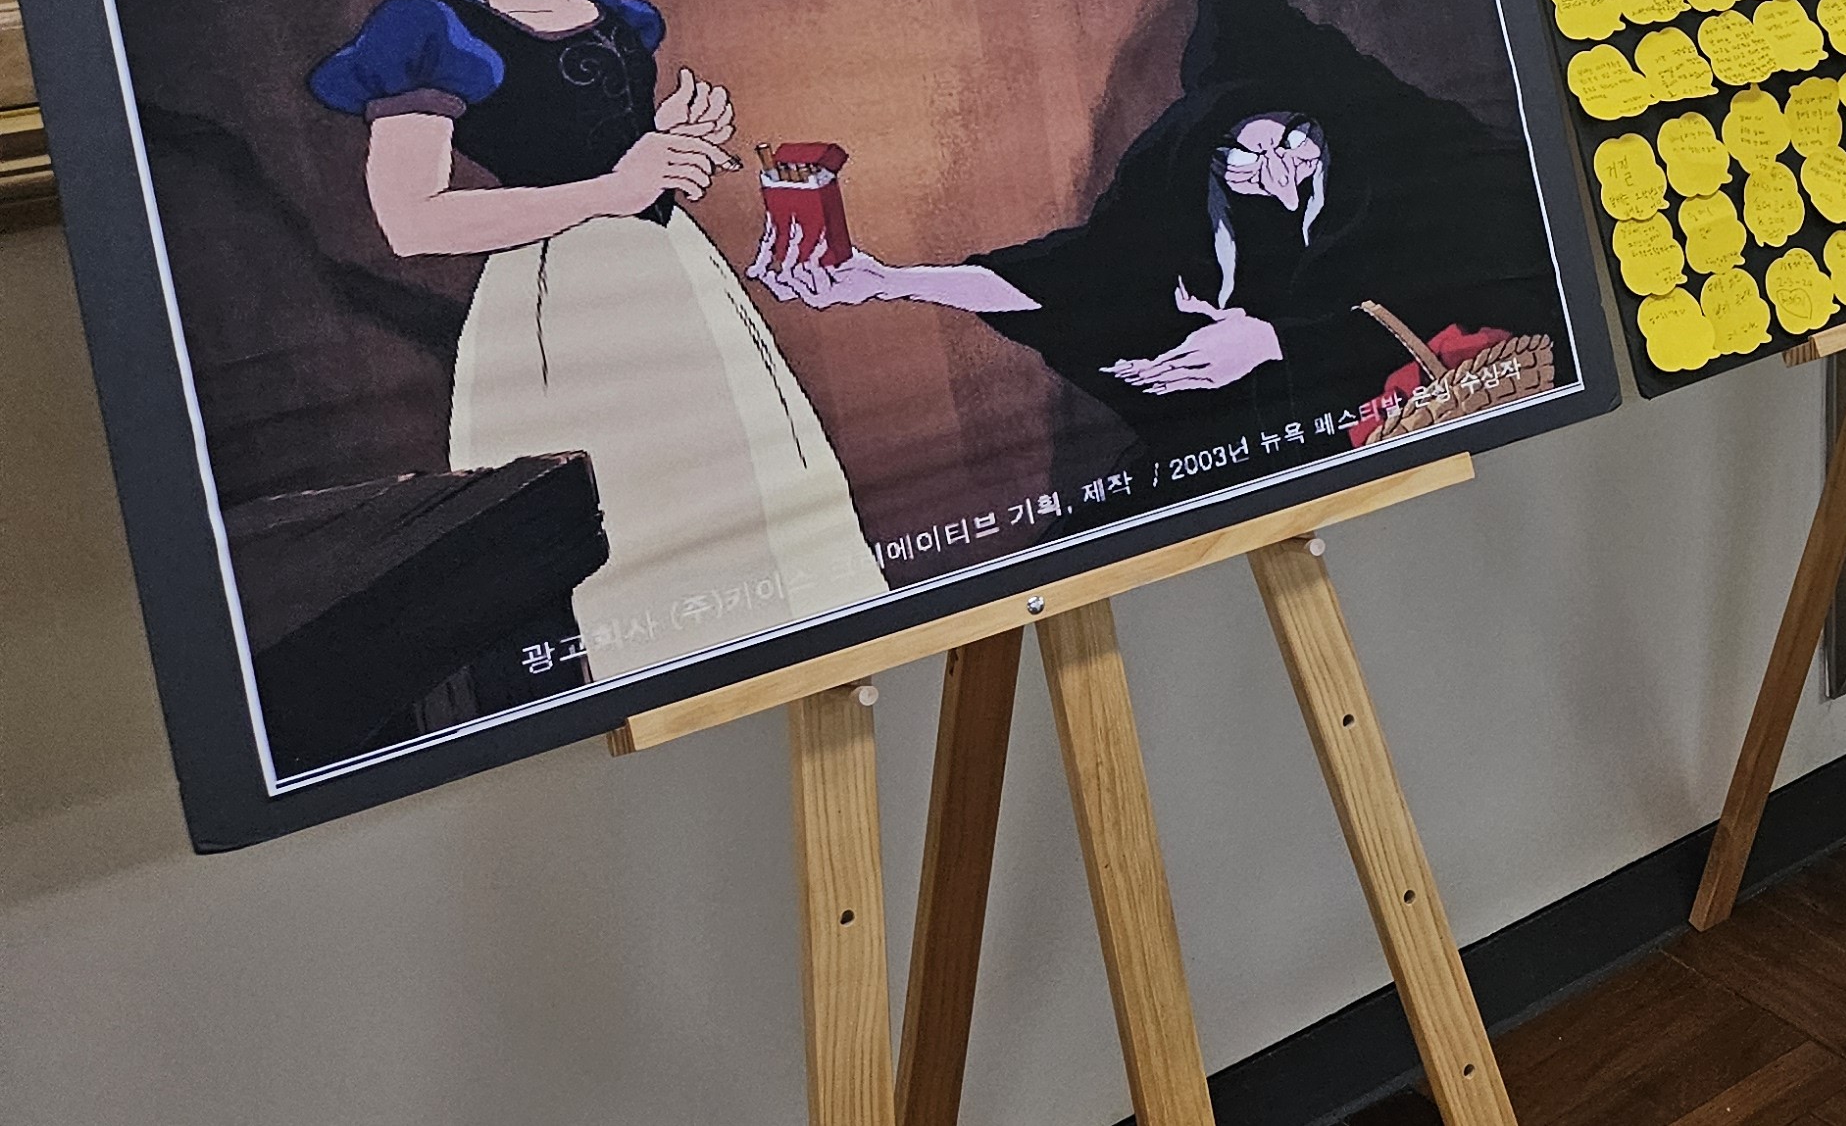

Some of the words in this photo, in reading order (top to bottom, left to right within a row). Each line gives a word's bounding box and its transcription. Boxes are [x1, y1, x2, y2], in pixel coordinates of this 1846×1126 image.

[1007, 491, 1073, 525] 기획,
[1082, 469, 1133, 503] 제작
[1169, 435, 1250, 482] 2003년
[1260, 421, 1305, 455] 뉴욕
[1313, 390, 1403, 437] 페스티발
[1458, 356, 1523, 396] 수상작
